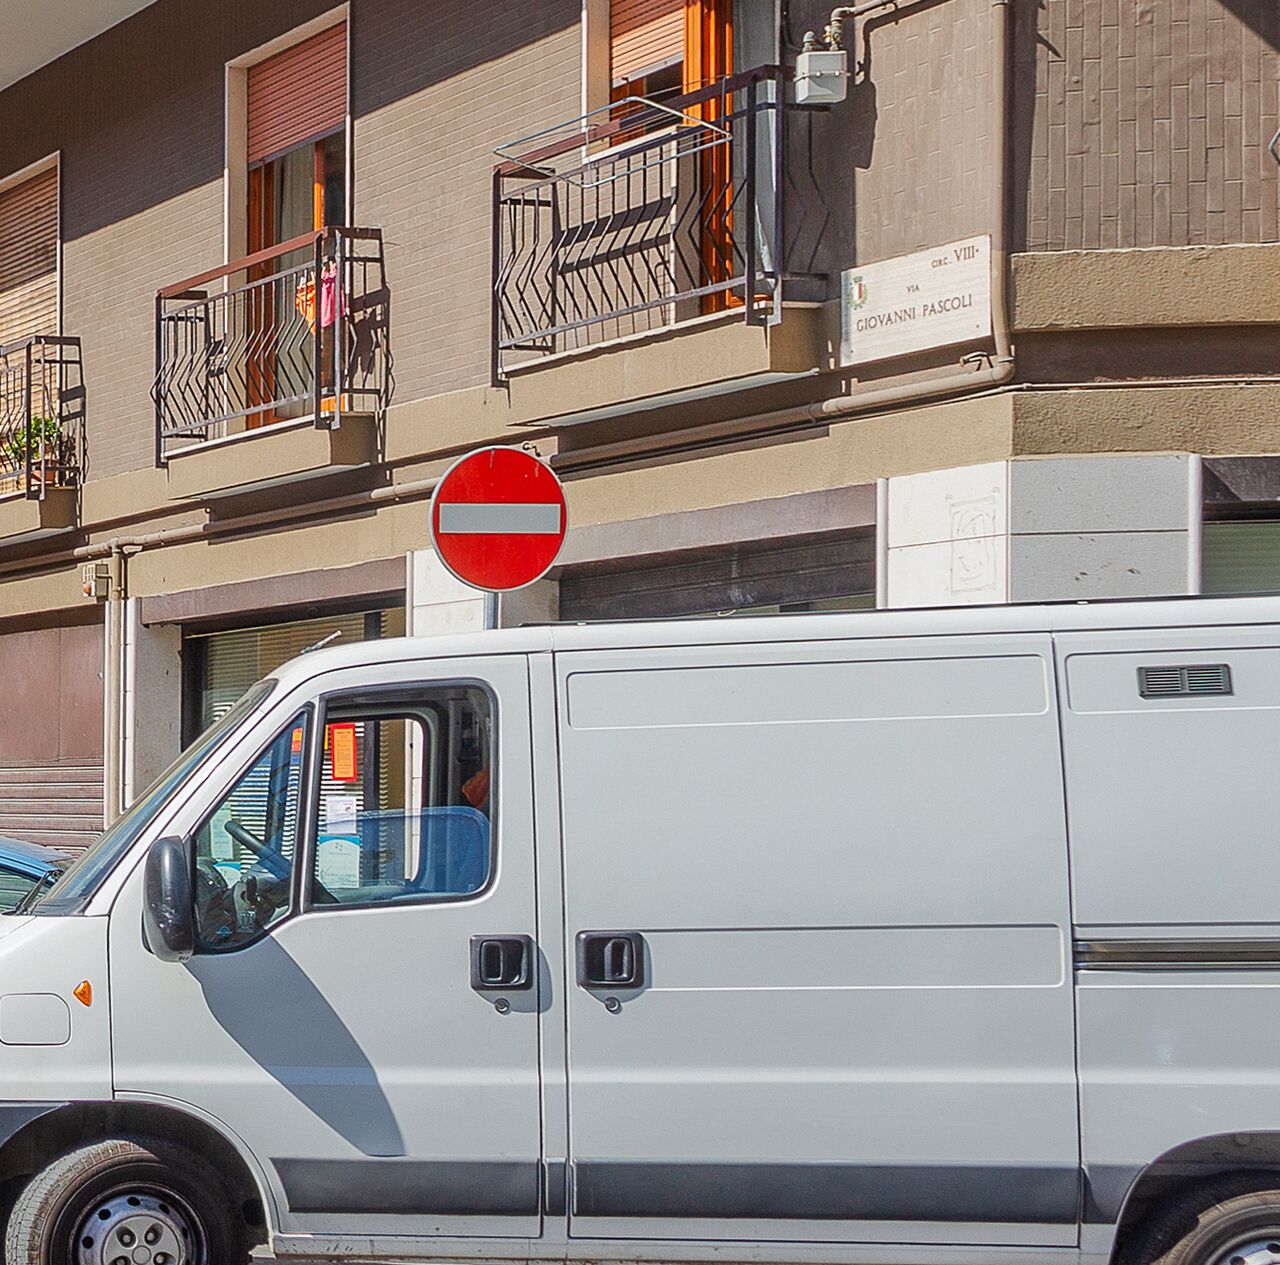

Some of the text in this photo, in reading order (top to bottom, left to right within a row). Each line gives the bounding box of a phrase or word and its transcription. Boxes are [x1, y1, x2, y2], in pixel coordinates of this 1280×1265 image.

[931, 256, 952, 269] CIRC.
[906, 284, 920, 294] VIA
[856, 293, 972, 332] GIOVANNI PASCOLI
